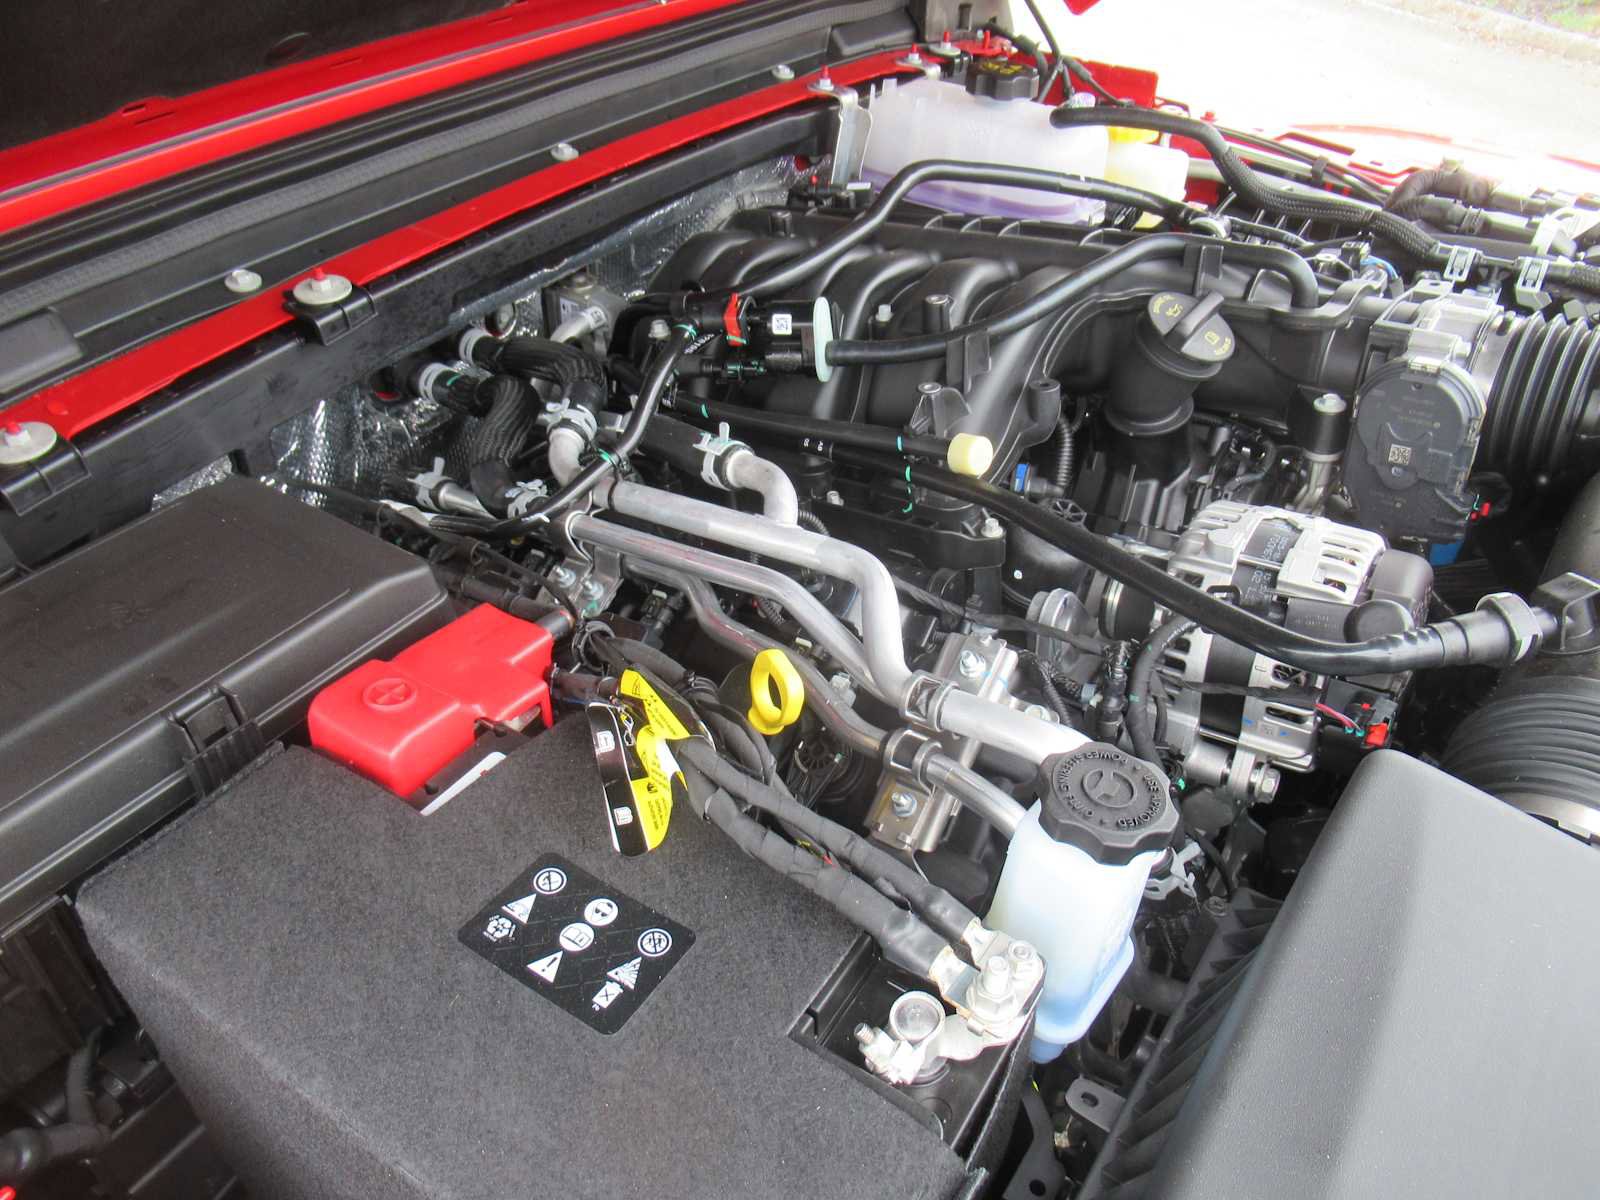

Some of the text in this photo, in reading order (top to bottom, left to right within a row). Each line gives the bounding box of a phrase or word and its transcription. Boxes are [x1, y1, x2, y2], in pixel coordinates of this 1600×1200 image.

[1056, 753, 1084, 791] STEERING
[1086, 751, 1129, 764] POWER
[1117, 774, 1162, 828] USE APPROVED
